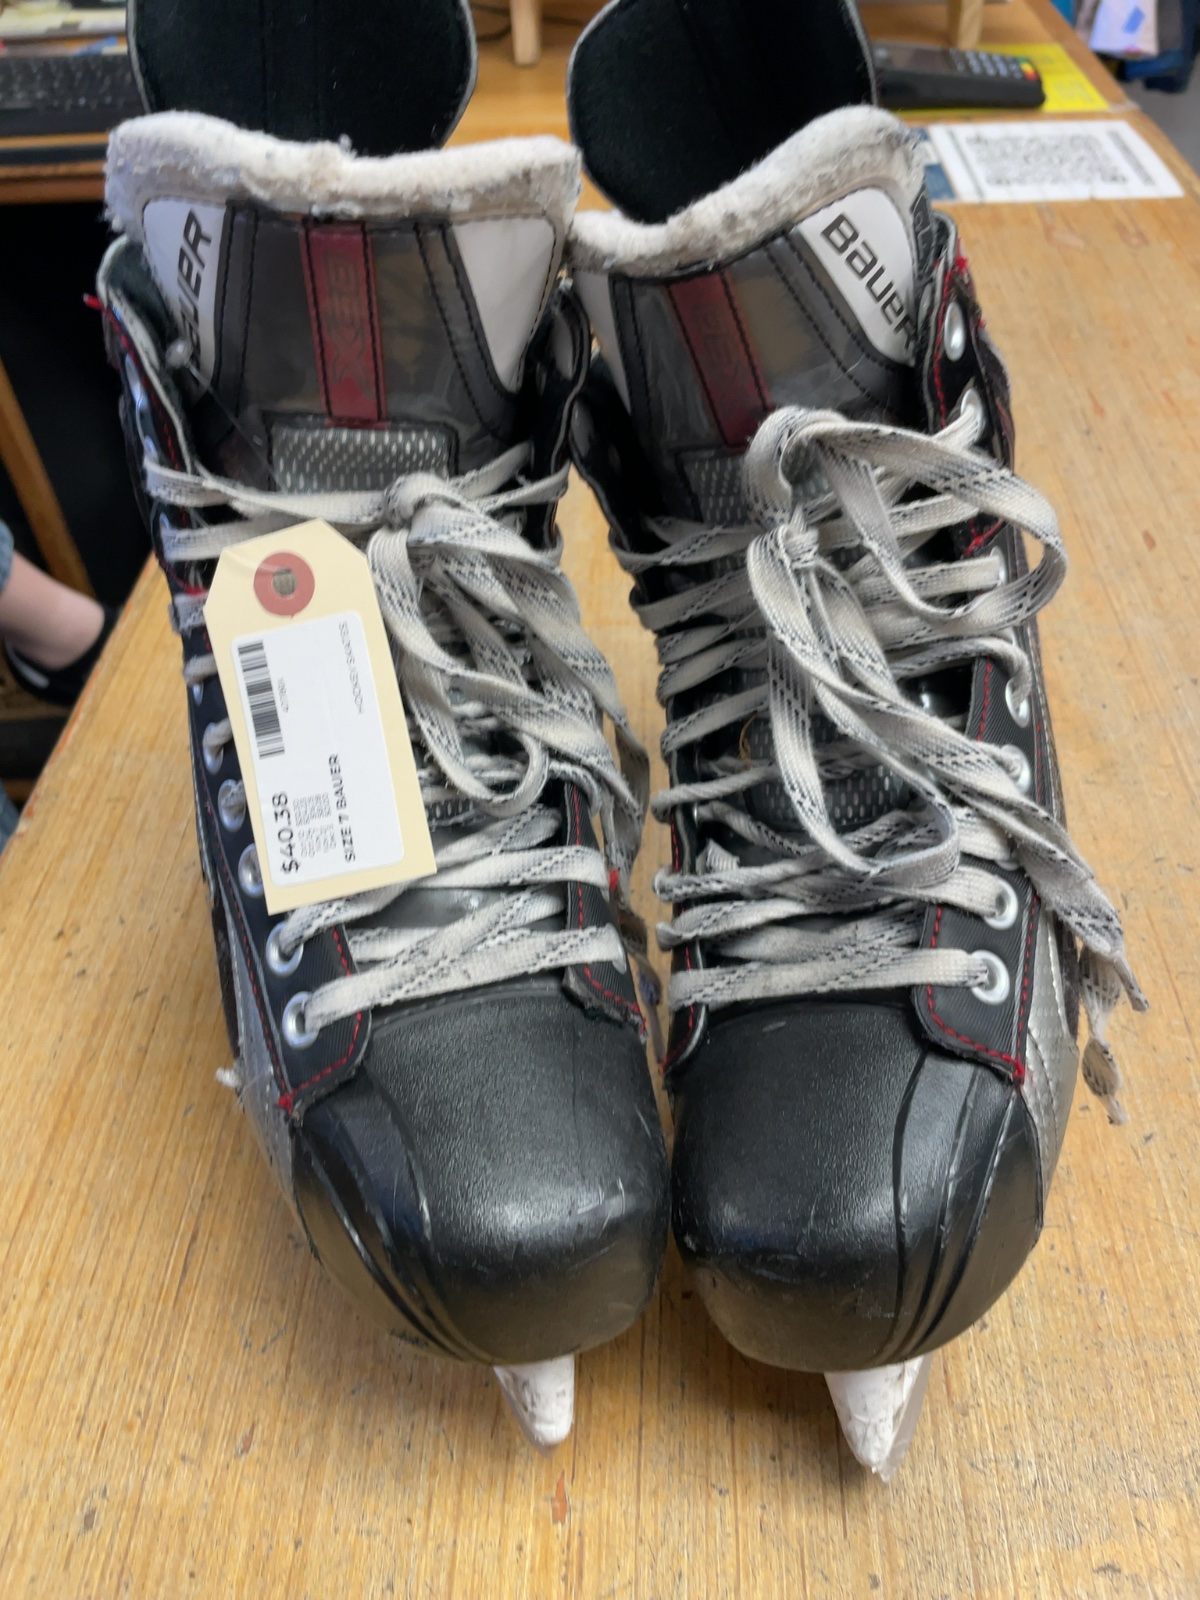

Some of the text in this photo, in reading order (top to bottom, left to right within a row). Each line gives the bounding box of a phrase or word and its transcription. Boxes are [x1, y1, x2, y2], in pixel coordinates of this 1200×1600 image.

[272, 791, 300, 875] $40.38
[328, 753, 356, 863] SIZE 7 BAUER
